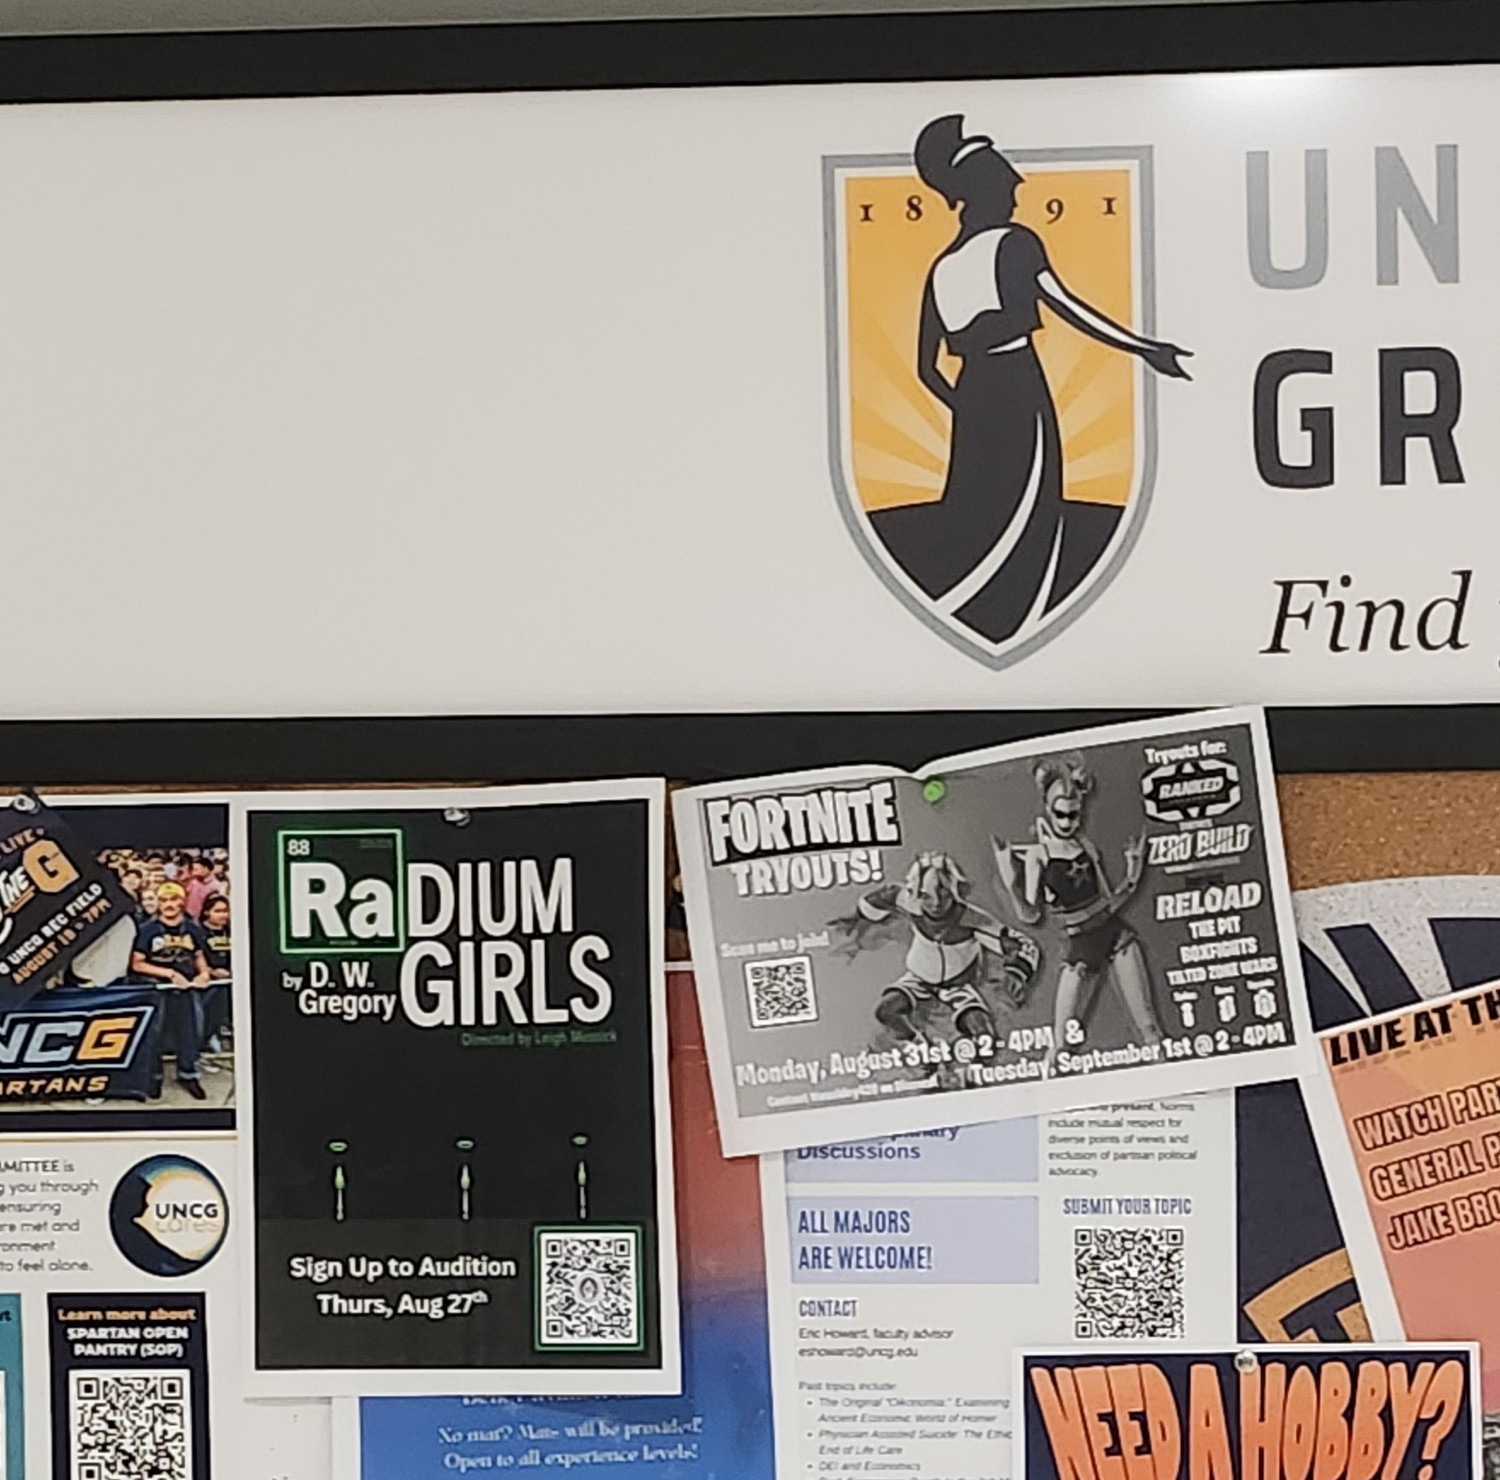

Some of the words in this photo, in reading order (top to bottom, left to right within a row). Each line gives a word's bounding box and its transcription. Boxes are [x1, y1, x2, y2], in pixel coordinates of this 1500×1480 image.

[1258, 569, 1474, 656] Find
[707, 781, 899, 861] FORTNITE
[288, 840, 310, 855] 88
[732, 851, 883, 897] TRYOUTS!
[401, 935, 611, 1028] GIRLS
[299, 990, 396, 1021] Gregory
[1331, 1025, 1407, 1066] LIVE
[1414, 1009, 1456, 1040] AT
[736, 1060, 827, 1088] Monday,
[831, 1050, 900, 1078] August
[905, 1039, 953, 1067] 31st
[1355, 1098, 1446, 1151] WATCH
[1369, 1141, 1483, 1201] GENERAL
[155, 1204, 218, 1218] UNCG
[1063, 1198, 1113, 1215] SUBMIT
[1116, 1198, 1151, 1215] YOUR
[1153, 1198, 1192, 1215] TOPIC
[798, 1210, 829, 1234] ALL
[834, 1210, 911, 1235] MAJORS
[1386, 1203, 1452, 1251] JAKE
[290, 1257, 343, 1282] Sign
[348, 1257, 383, 1282] Up
[388, 1258, 414, 1279] to
[419, 1256, 515, 1278] Audition
[798, 1246, 833, 1270] ARE
[838, 1246, 933, 1270] WELCOME!
[317, 1294, 392, 1318] Thurs,
[398, 1294, 443, 1319] Aug
[798, 1300, 858, 1317] CONTACT
[67, 1327, 140, 1340] SPARTAN
[143, 1326, 189, 1339] OPEN
[74, 1344, 138, 1356] PANTRY
[140, 1343, 183, 1358] (SOP)
